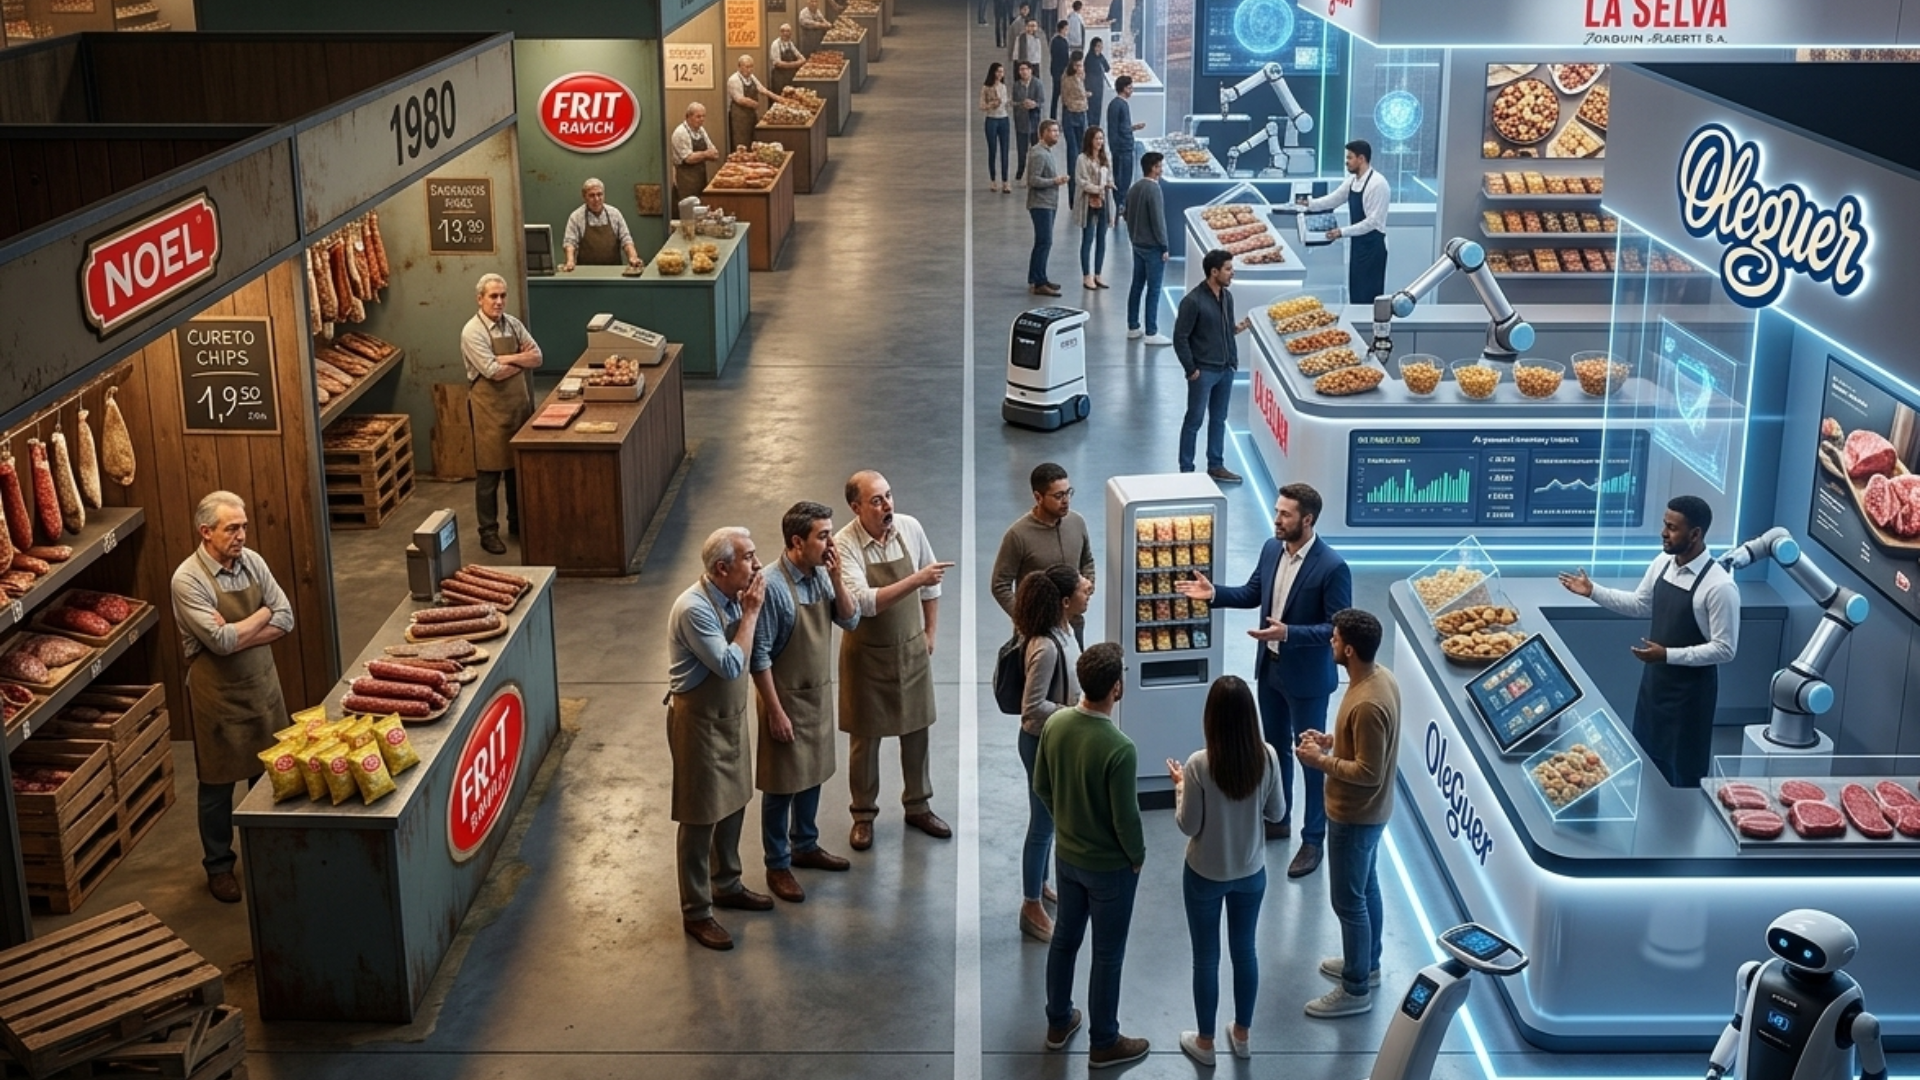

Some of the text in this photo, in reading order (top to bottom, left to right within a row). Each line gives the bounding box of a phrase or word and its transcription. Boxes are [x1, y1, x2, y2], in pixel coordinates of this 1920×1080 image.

[1585, 0, 1728, 28] LA SELVA
[390, 80, 456, 166] 1980
[552, 91, 623, 120] FRIT
[559, 121, 614, 134] RAVICH
[1679, 127, 1862, 299] Oleguer
[104, 223, 204, 308] NOEL
[187, 329, 255, 345] CURETO
[196, 350, 249, 366] CHIPS
[461, 705, 510, 824] FRIT
[1425, 720, 1493, 867] Oleguer
